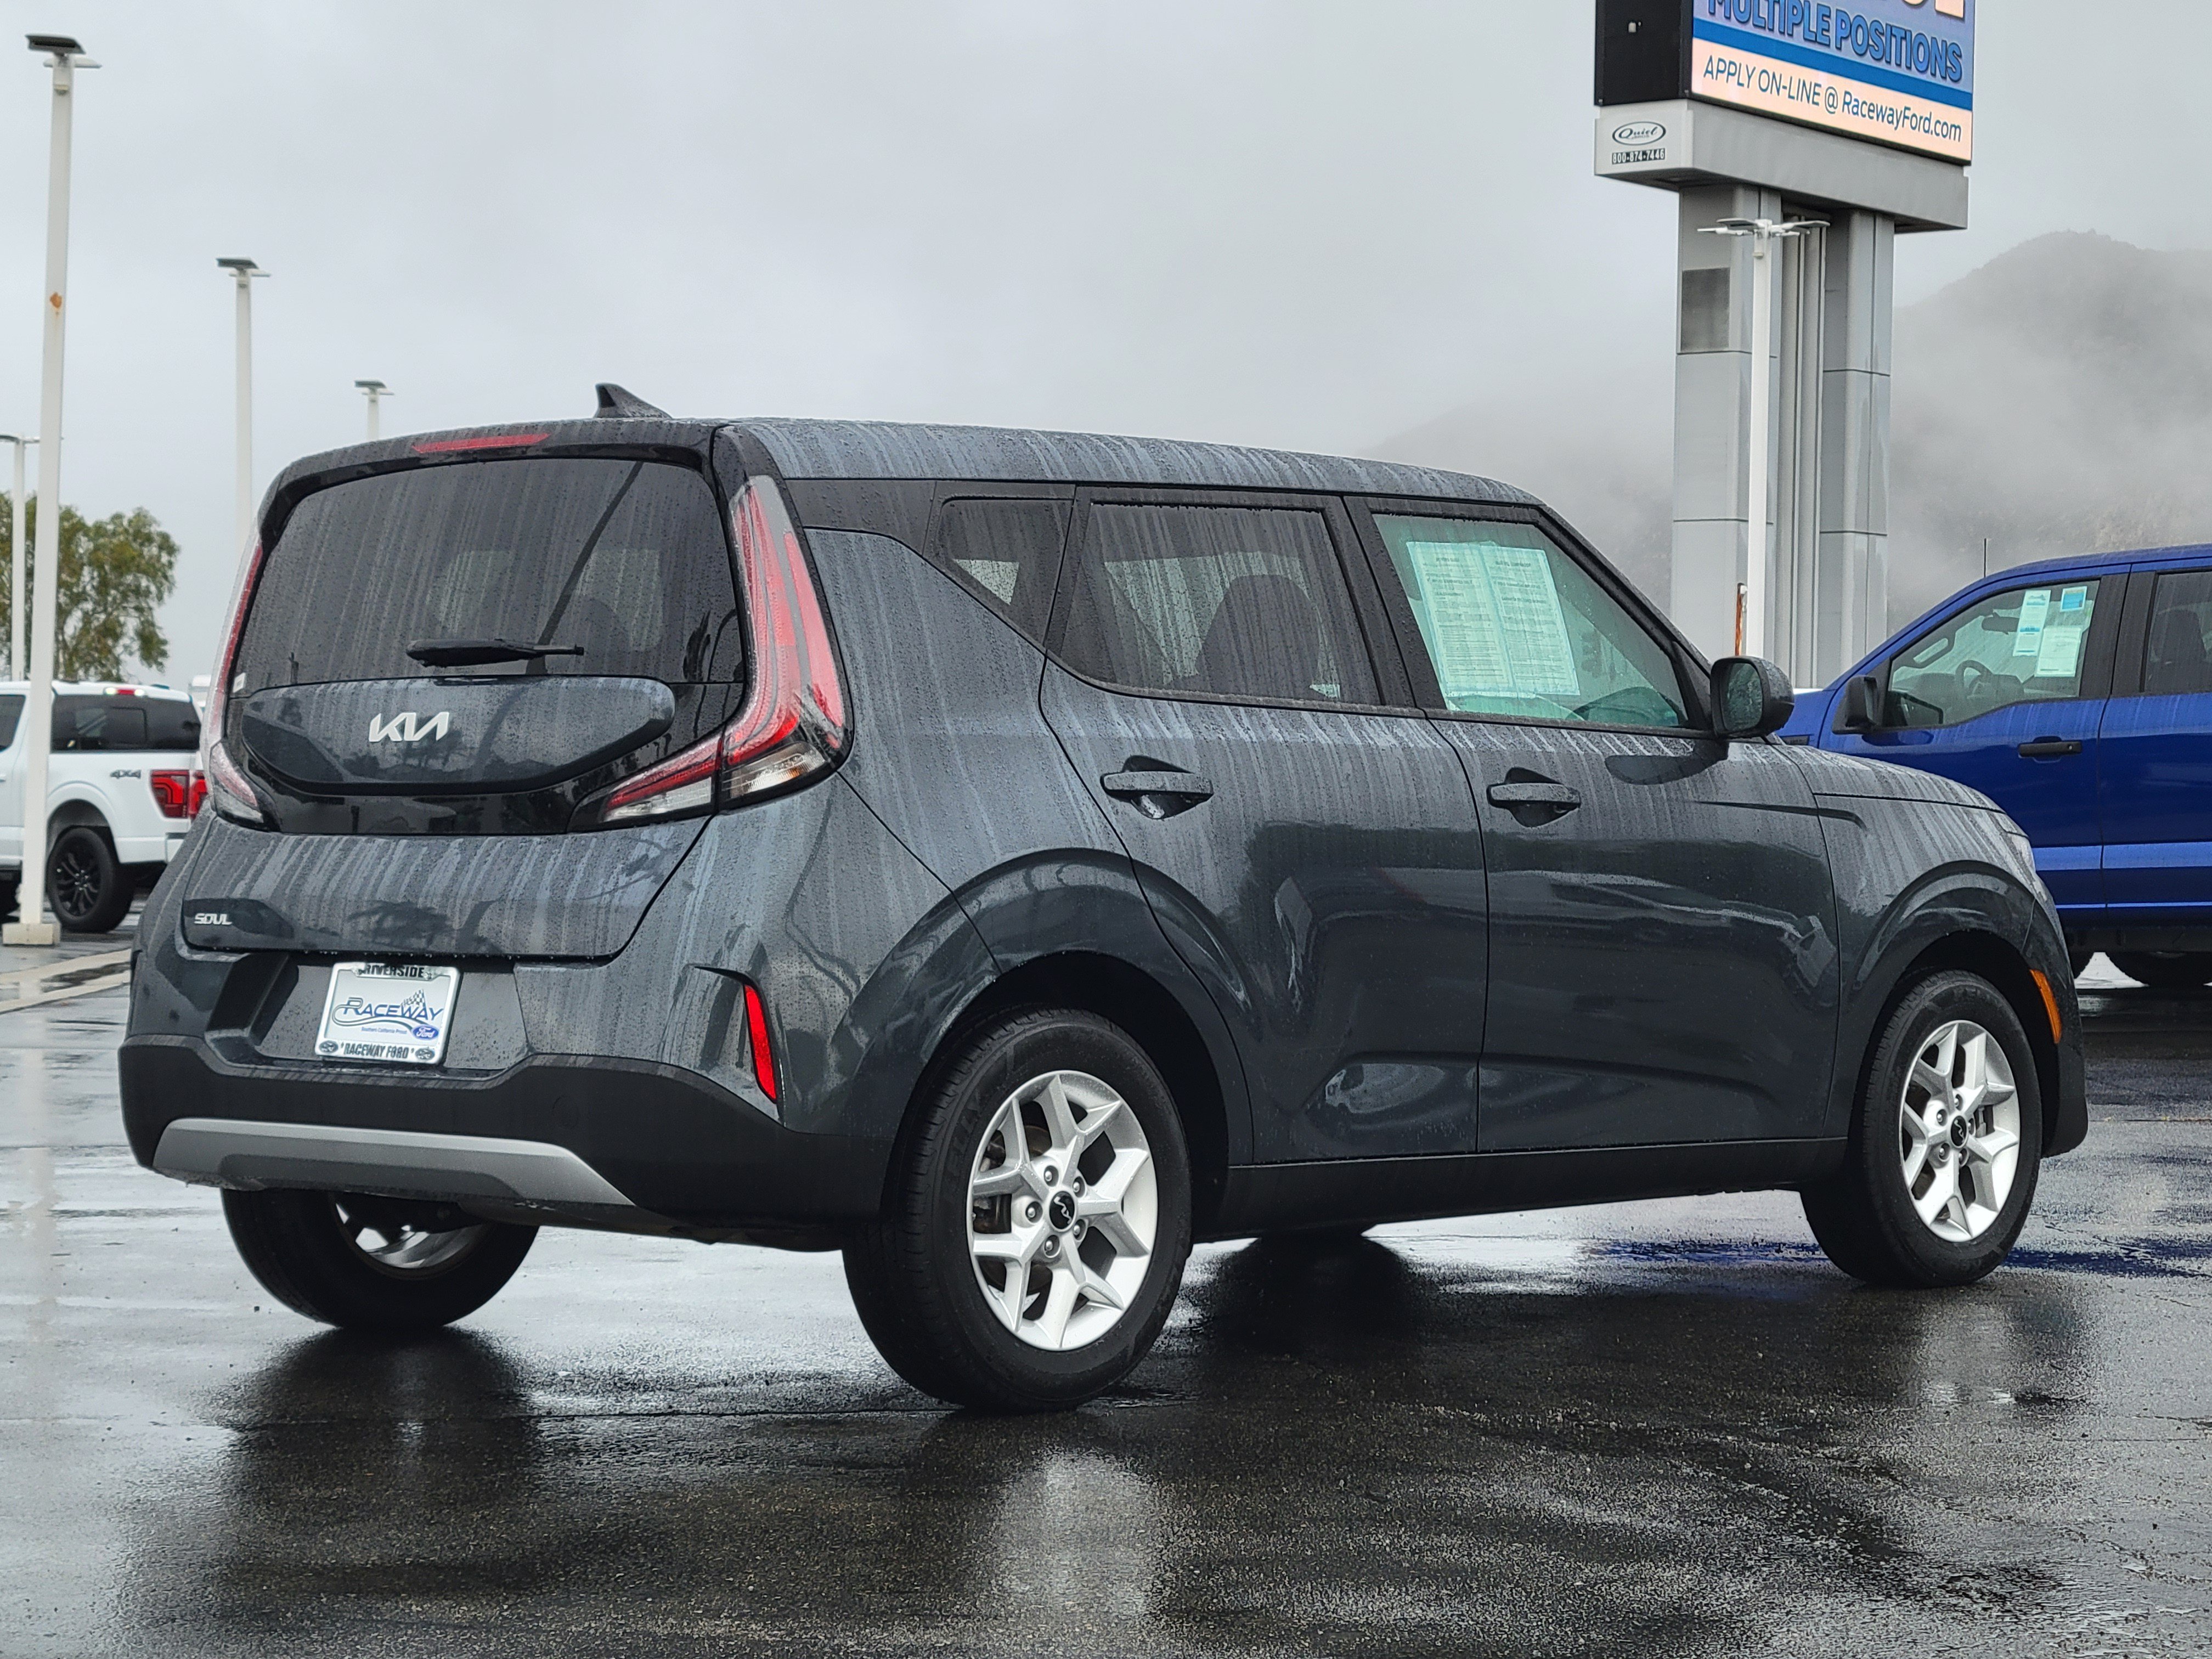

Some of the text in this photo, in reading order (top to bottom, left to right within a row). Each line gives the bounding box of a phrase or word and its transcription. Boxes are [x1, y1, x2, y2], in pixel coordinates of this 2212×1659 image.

[1835, 8, 1963, 82] POSITIONS
[1703, 55, 1962, 142] APPLY ON-LINE @ RacewayFord.com
[369, 712, 449, 742] KIA
[194, 913, 233, 926] SOUL
[365, 964, 425, 978] RIVERSIDE
[343, 997, 444, 1019] RACEWAY
[416, 1026, 434, 1039] Ford
